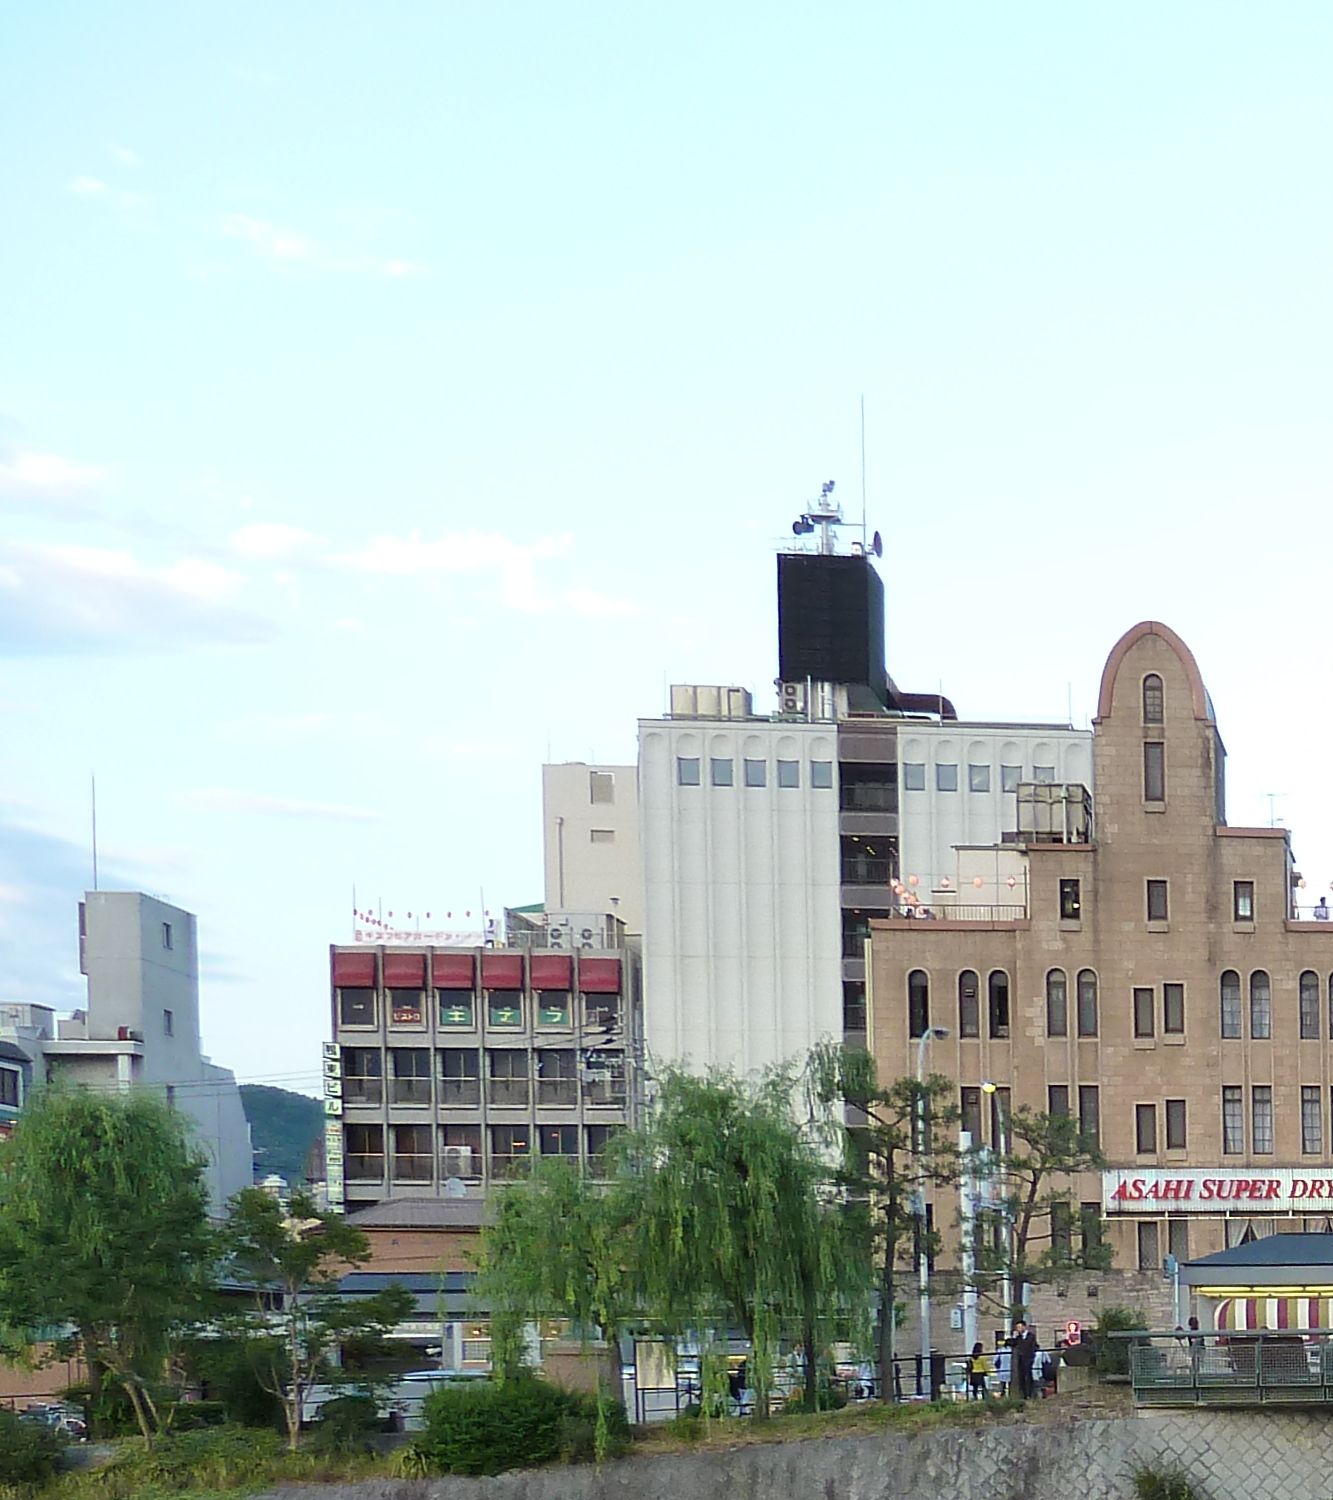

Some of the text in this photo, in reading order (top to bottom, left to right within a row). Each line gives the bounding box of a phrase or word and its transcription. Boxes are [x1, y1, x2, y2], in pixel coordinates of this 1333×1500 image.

[393, 1012, 421, 1021] ビストロ
[1110, 1179, 1195, 1199] ASAHI
[1199, 1179, 1282, 1199] SUPER
